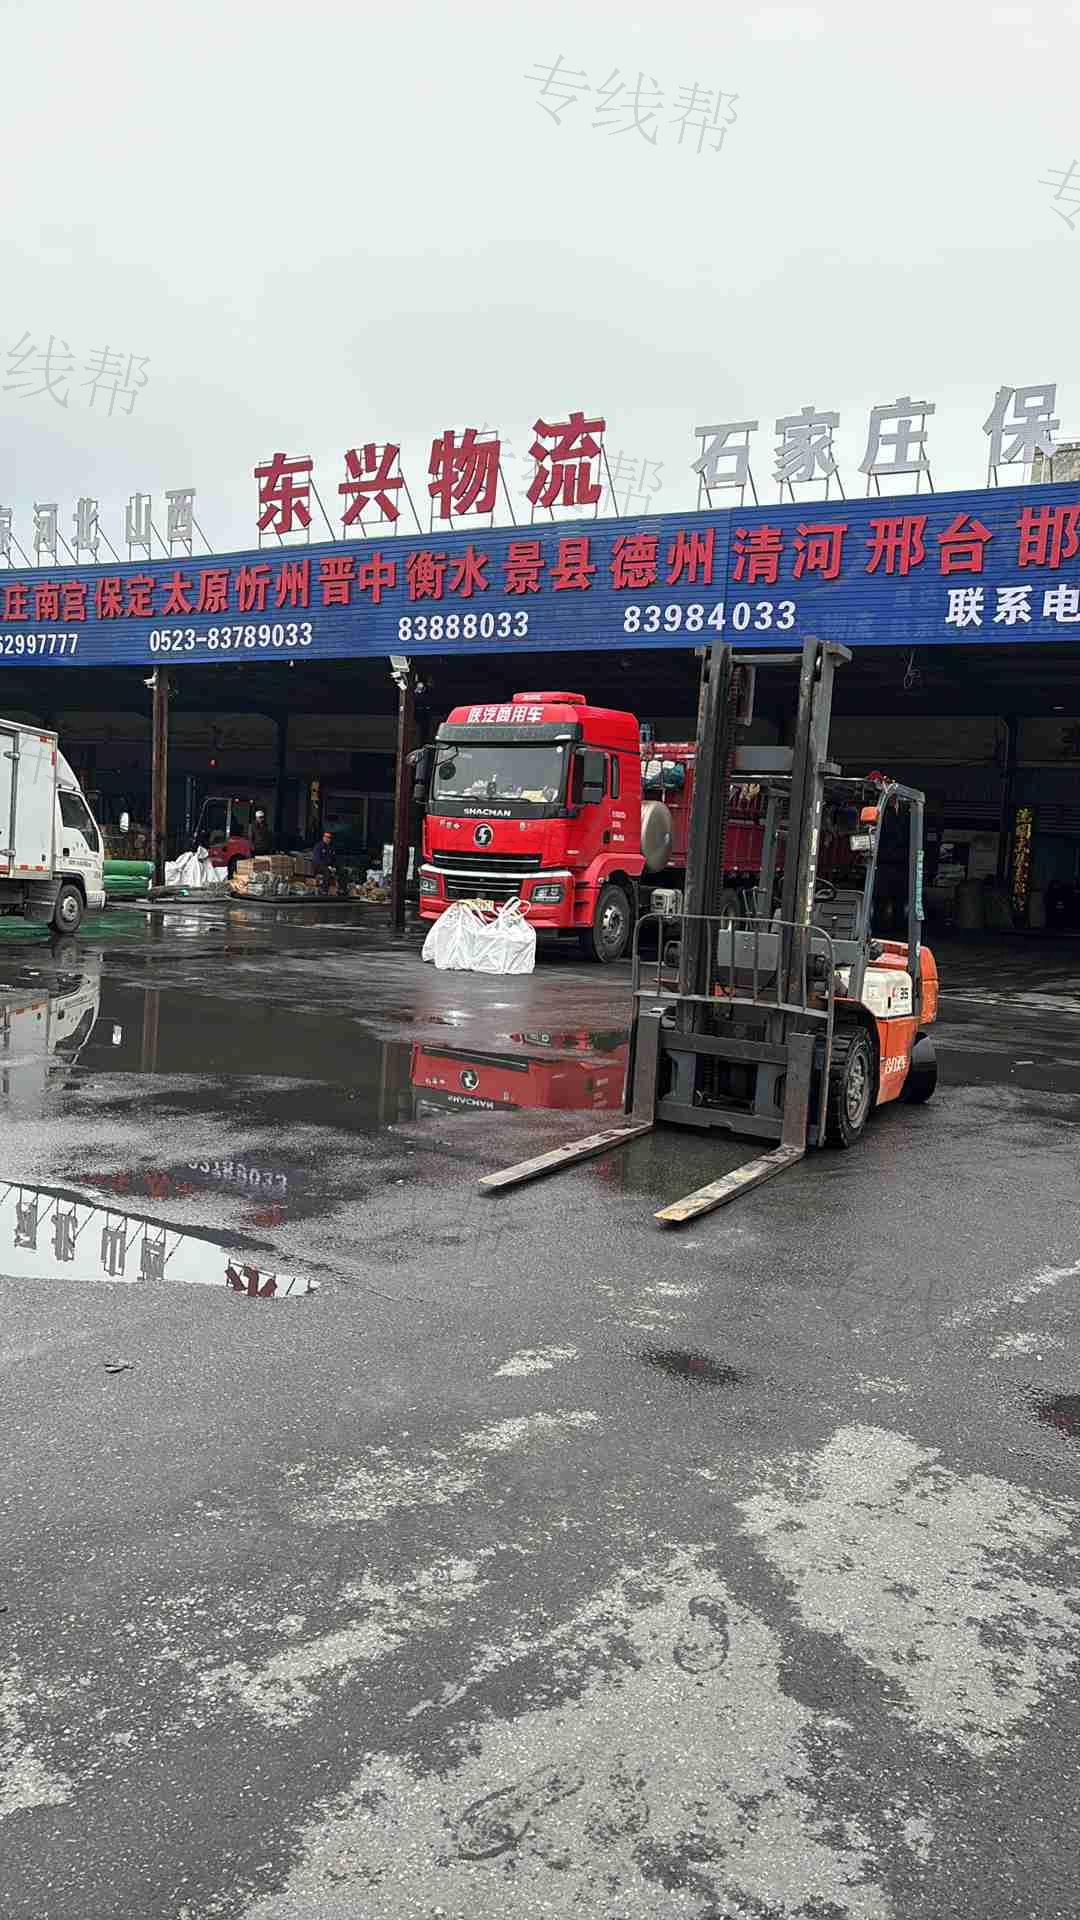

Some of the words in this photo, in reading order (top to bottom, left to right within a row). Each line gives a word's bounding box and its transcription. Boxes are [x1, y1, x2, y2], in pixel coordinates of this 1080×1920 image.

[255, 412, 606, 534] 东兴物流
[398, 611, 529, 641] 83888033
[623, 600, 796, 633] 83984033
[150, 622, 313, 652] 0523-83789033
[463, 808, 512, 817] SHACMAN
